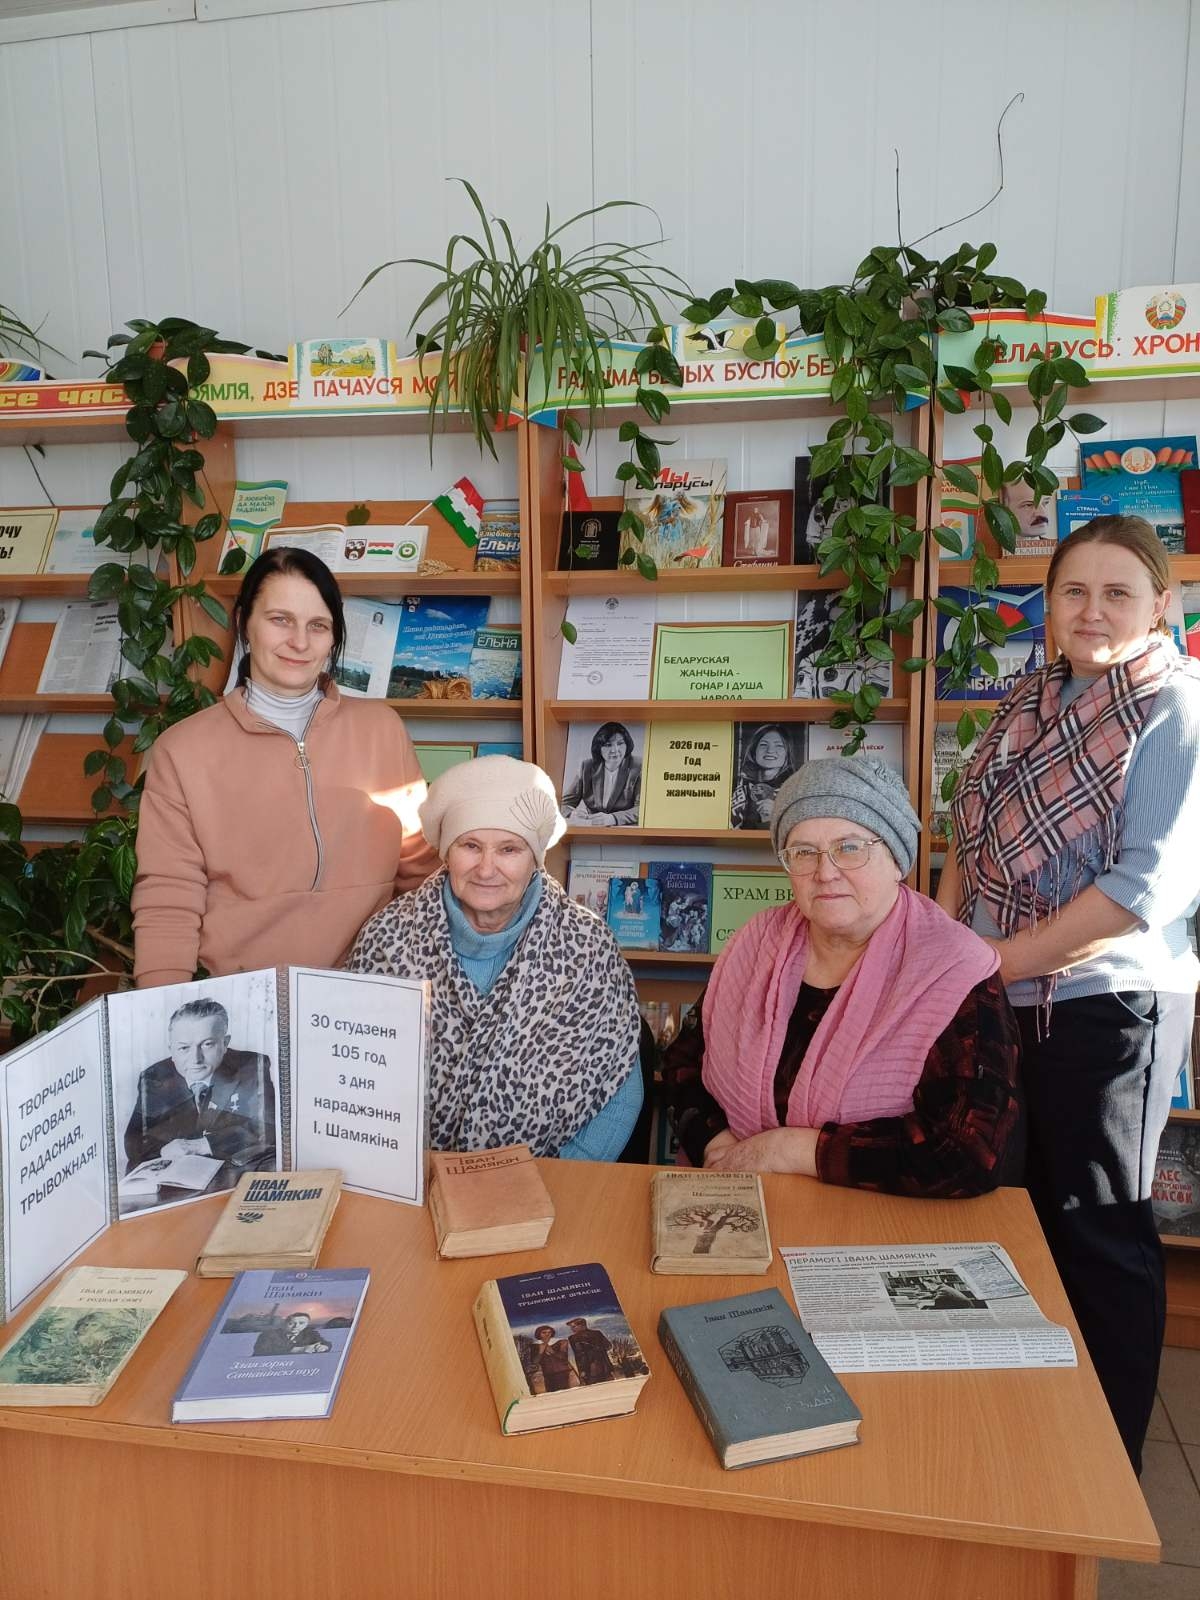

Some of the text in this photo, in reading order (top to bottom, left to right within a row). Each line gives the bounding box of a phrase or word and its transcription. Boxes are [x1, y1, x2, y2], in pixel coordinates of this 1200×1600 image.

[263, 381, 299, 401] ДЗЕ
[313, 373, 403, 397] ПАЧАЎСЯ
[663, 656, 730, 664] БЕЛАРУСКАЯ
[680, 669, 734, 677] ЖАНЧЫНА
[690, 682, 724, 690] ГОНАР
[731, 682, 764, 691] ДУША
[669, 740, 692, 750] 2026
[693, 741, 711, 751] год
[684, 756, 702, 767] Год
[663, 771, 721, 782] беларускай
[666, 789, 716, 798] жанчыны
[723, 888, 770, 900] ХРАМ
[311, 1014, 397, 1039] 30 студзеня
[331, 1044, 387, 1067] 105 год
[350, 1077, 375, 1090] дня
[18, 1065, 87, 1120] ТВОРЧАСЦЬ
[314, 1096, 401, 1123] нараджэння
[20, 1101, 76, 1151] СУРОВАЯ,
[326, 1123, 399, 1150] Шамякіна
[20, 1125, 84, 1184] РАДАСНАЯ,
[20, 1142, 97, 1215] ТРЫВОЖНАЯ!
[249, 1179, 290, 1191] ИВАН
[243, 1188, 323, 1202] ШАМЯКИН
[789, 1256, 841, 1265] ПЕРАМОГІ
[844, 1255, 876, 1263] ІВАНА
[879, 1252, 937, 1261] ШАМЯКІНА
